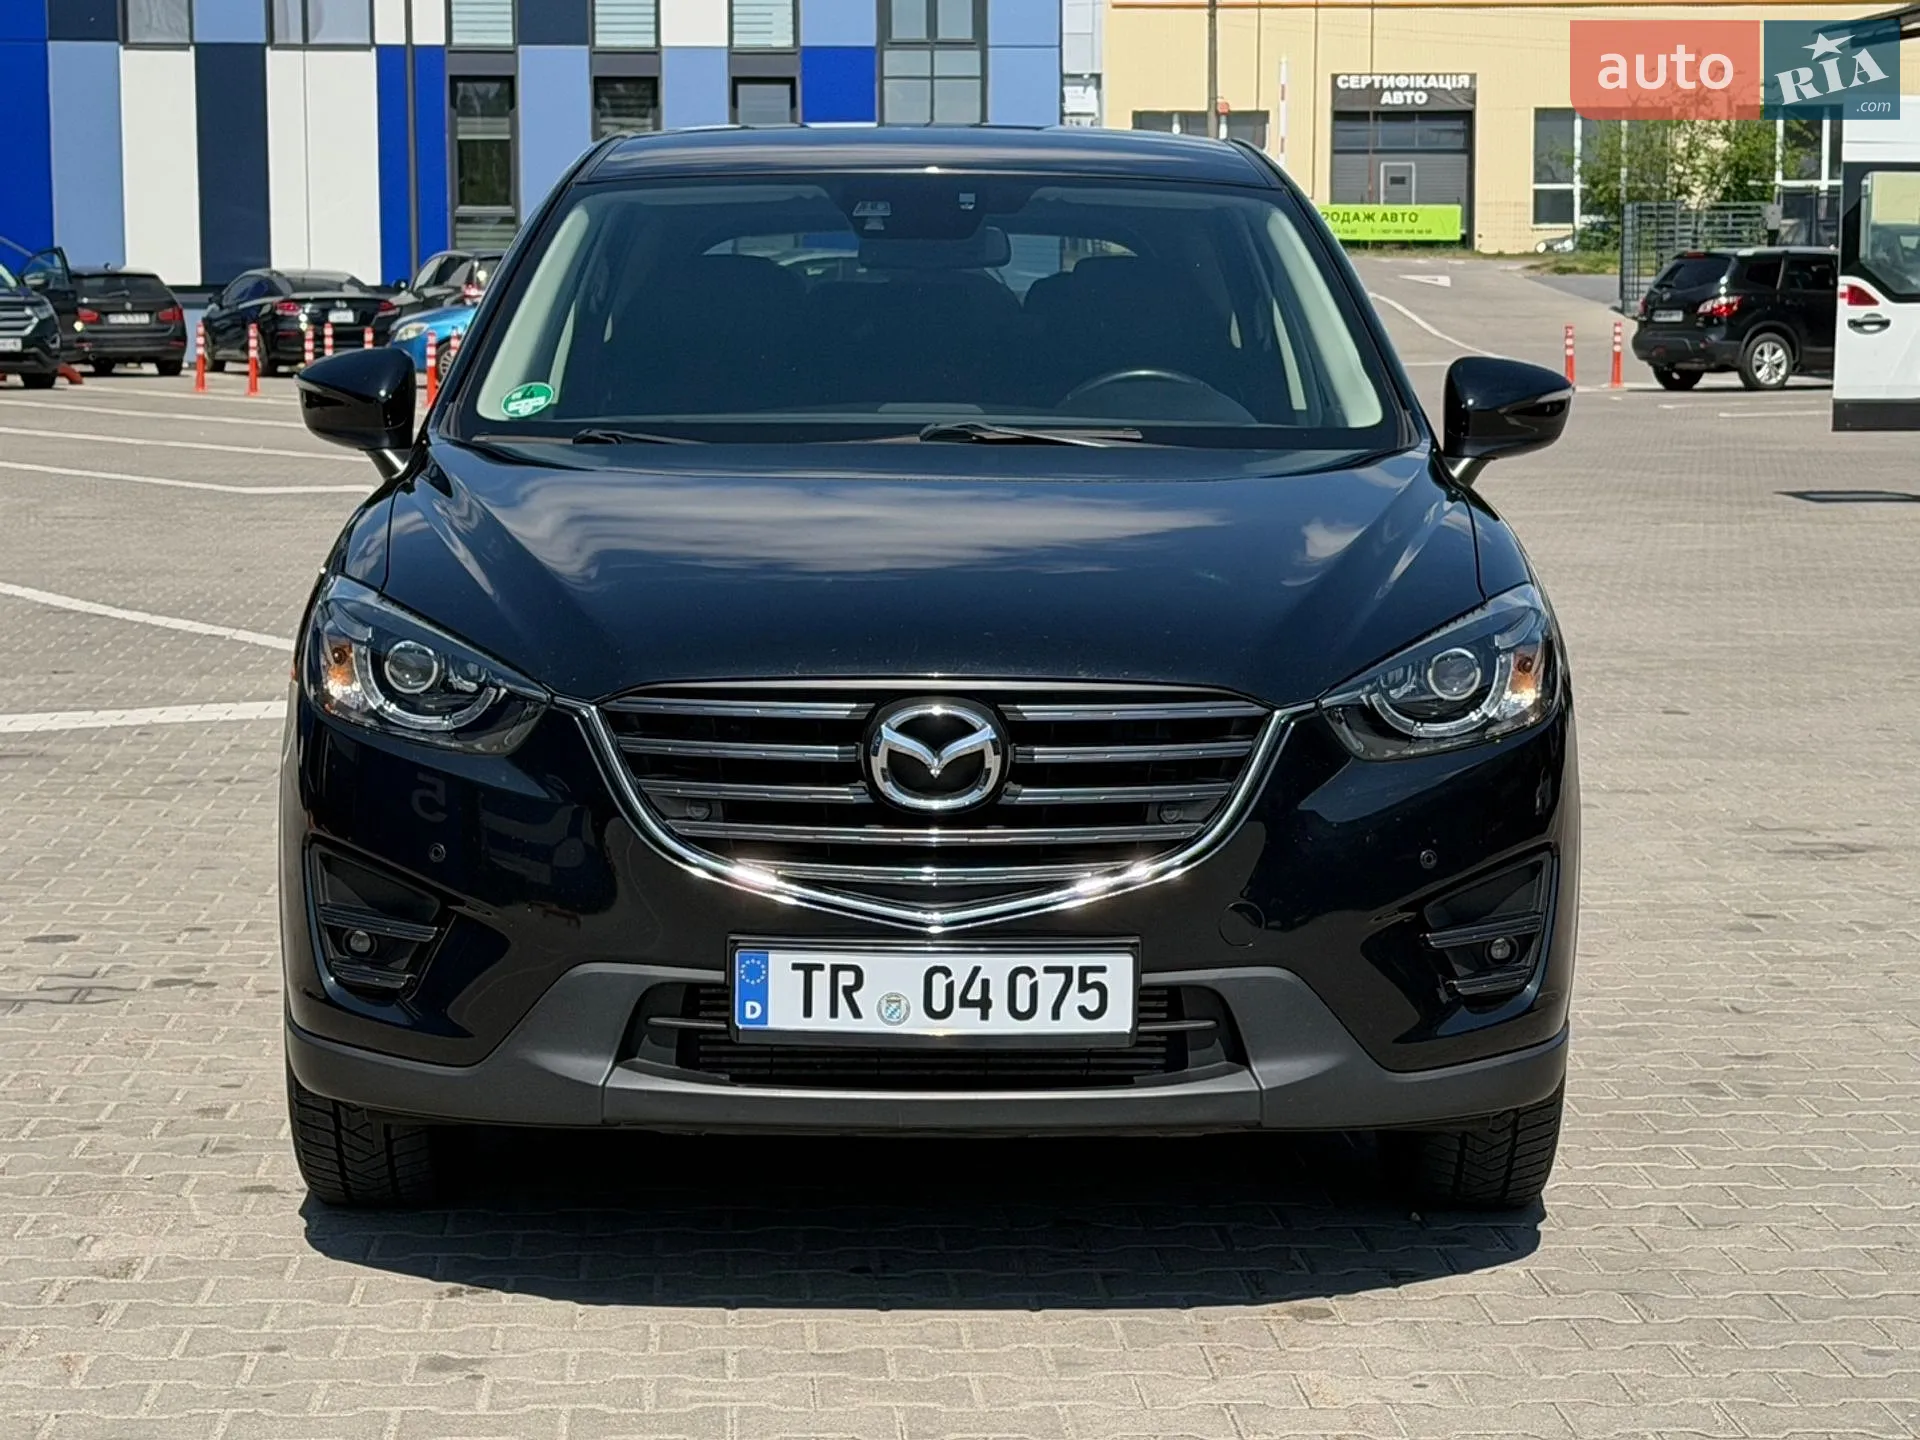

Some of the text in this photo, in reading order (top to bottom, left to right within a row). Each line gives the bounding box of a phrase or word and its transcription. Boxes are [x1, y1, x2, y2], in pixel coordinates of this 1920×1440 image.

[1336, 74, 1470, 90] СЕРТИФІКАЦІЯ
[1380, 90, 1428, 105] АВТО
[1380, 211, 1419, 223] АВТО
[791, 963, 864, 1019] TR
[745, 1001, 762, 1019] D
